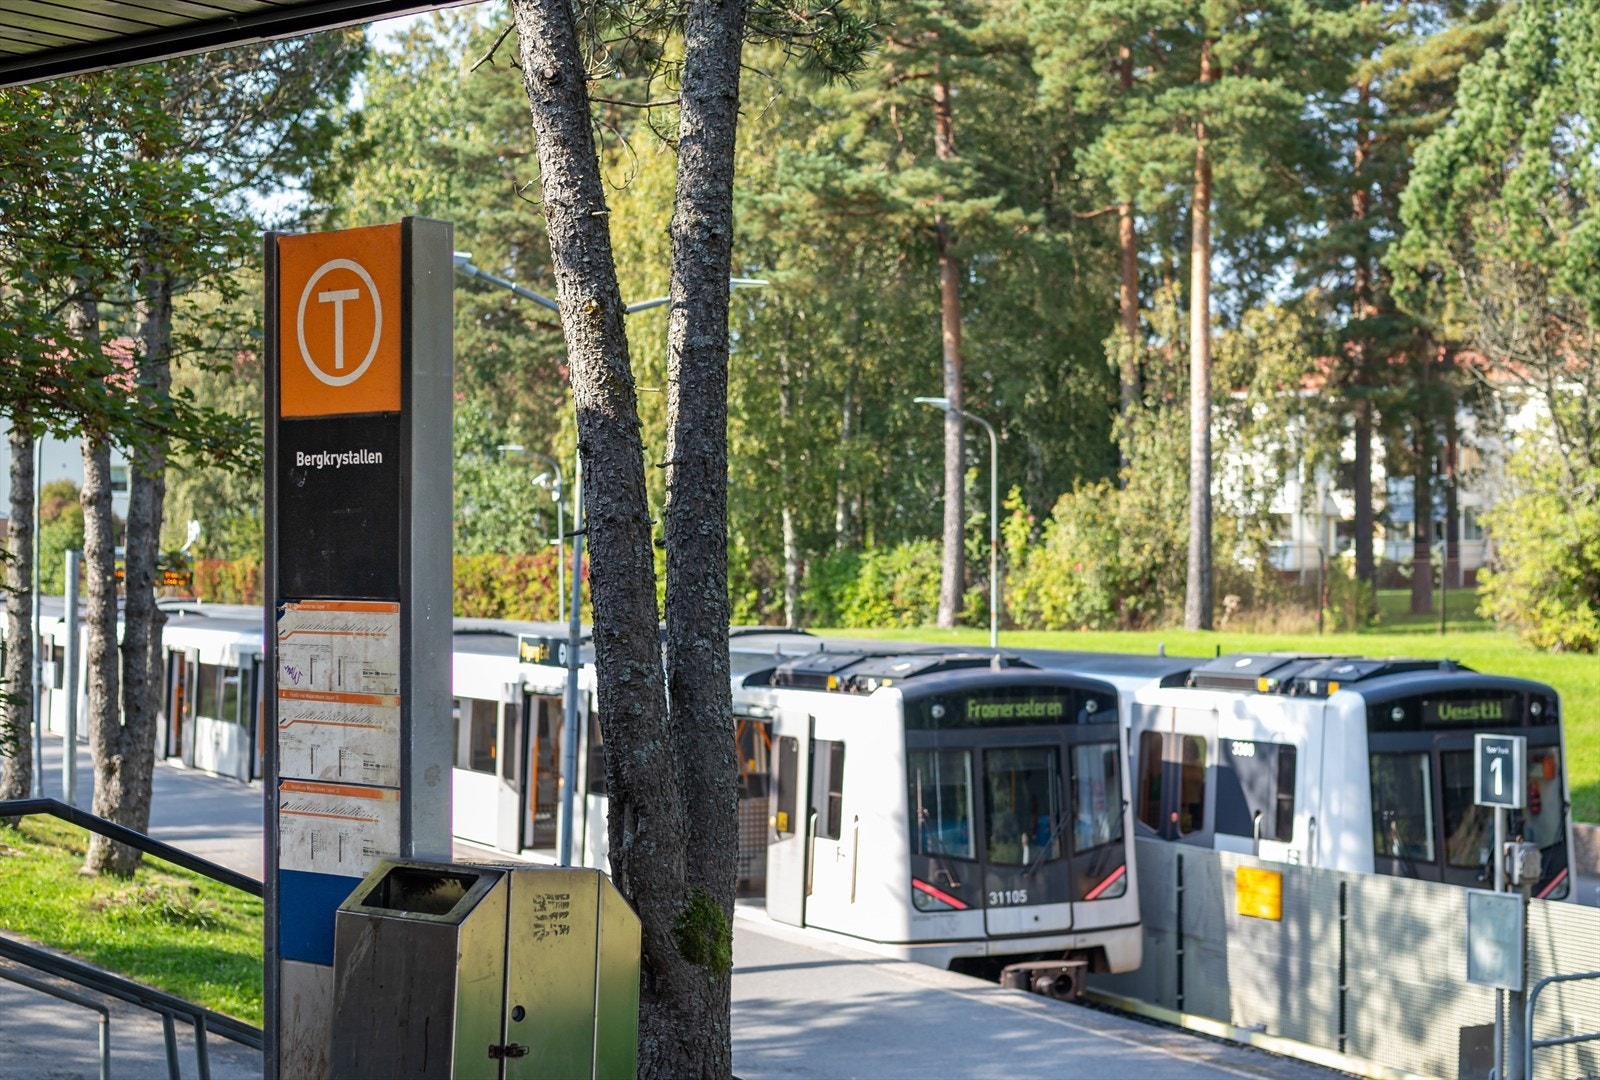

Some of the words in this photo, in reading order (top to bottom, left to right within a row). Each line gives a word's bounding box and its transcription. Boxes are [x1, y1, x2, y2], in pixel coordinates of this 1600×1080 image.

[318, 288, 360, 370] T
[296, 449, 383, 470] Bergkrystallen
[1489, 757, 1503, 796] 1
[988, 889, 1028, 906] 31105
